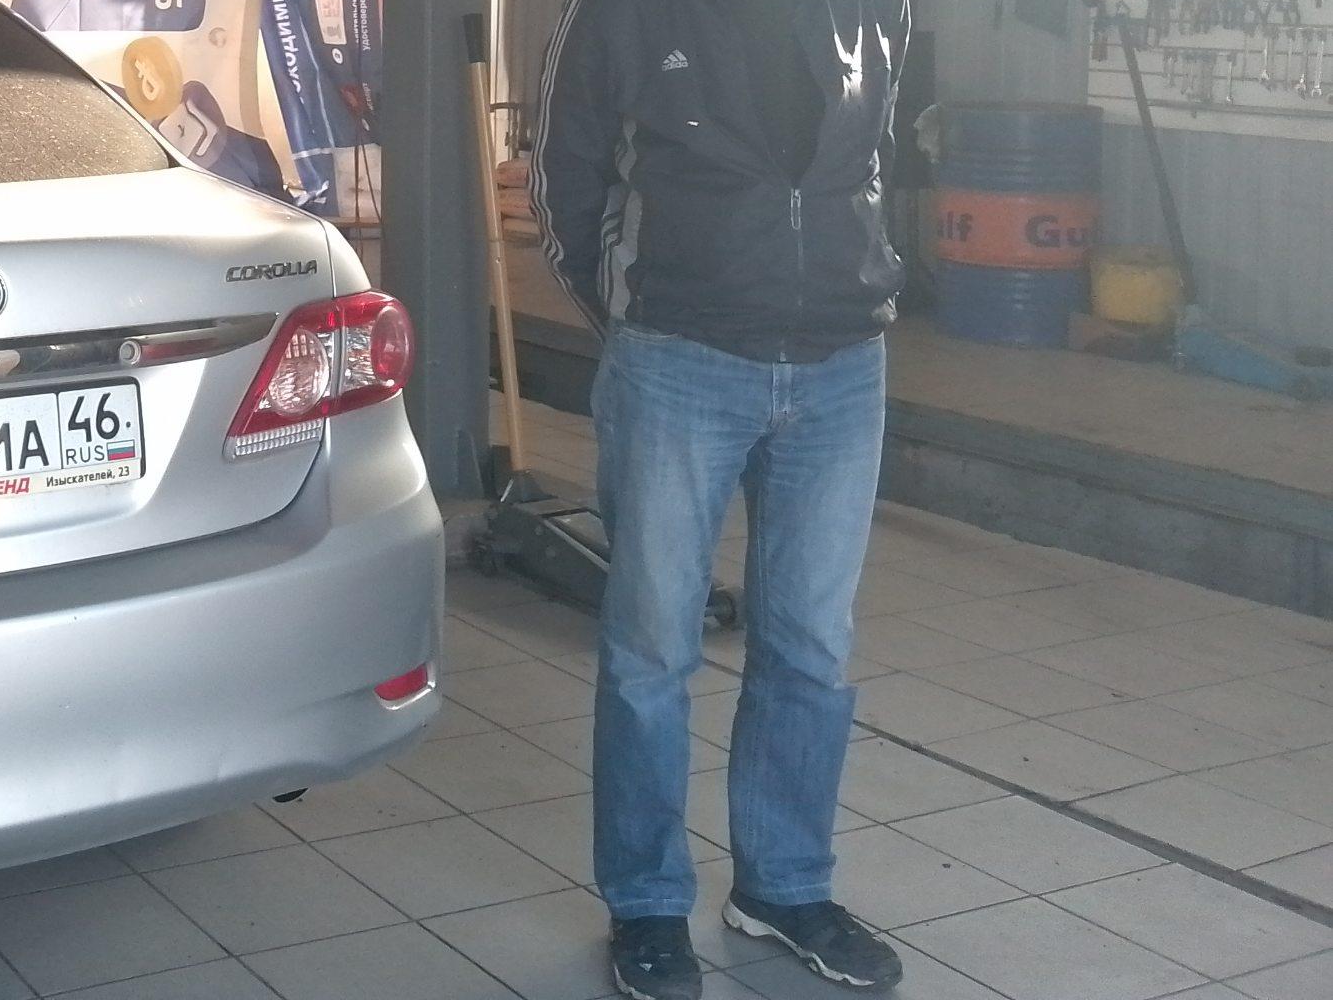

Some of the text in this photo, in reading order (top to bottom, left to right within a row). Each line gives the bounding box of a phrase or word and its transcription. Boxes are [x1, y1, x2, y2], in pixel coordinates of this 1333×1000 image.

[226, 260, 318, 282] COROLLA
[67, 392, 121, 442] 46
[67, 444, 106, 466] RUS
[46, 465, 131, 488] Изыскателей, 23
